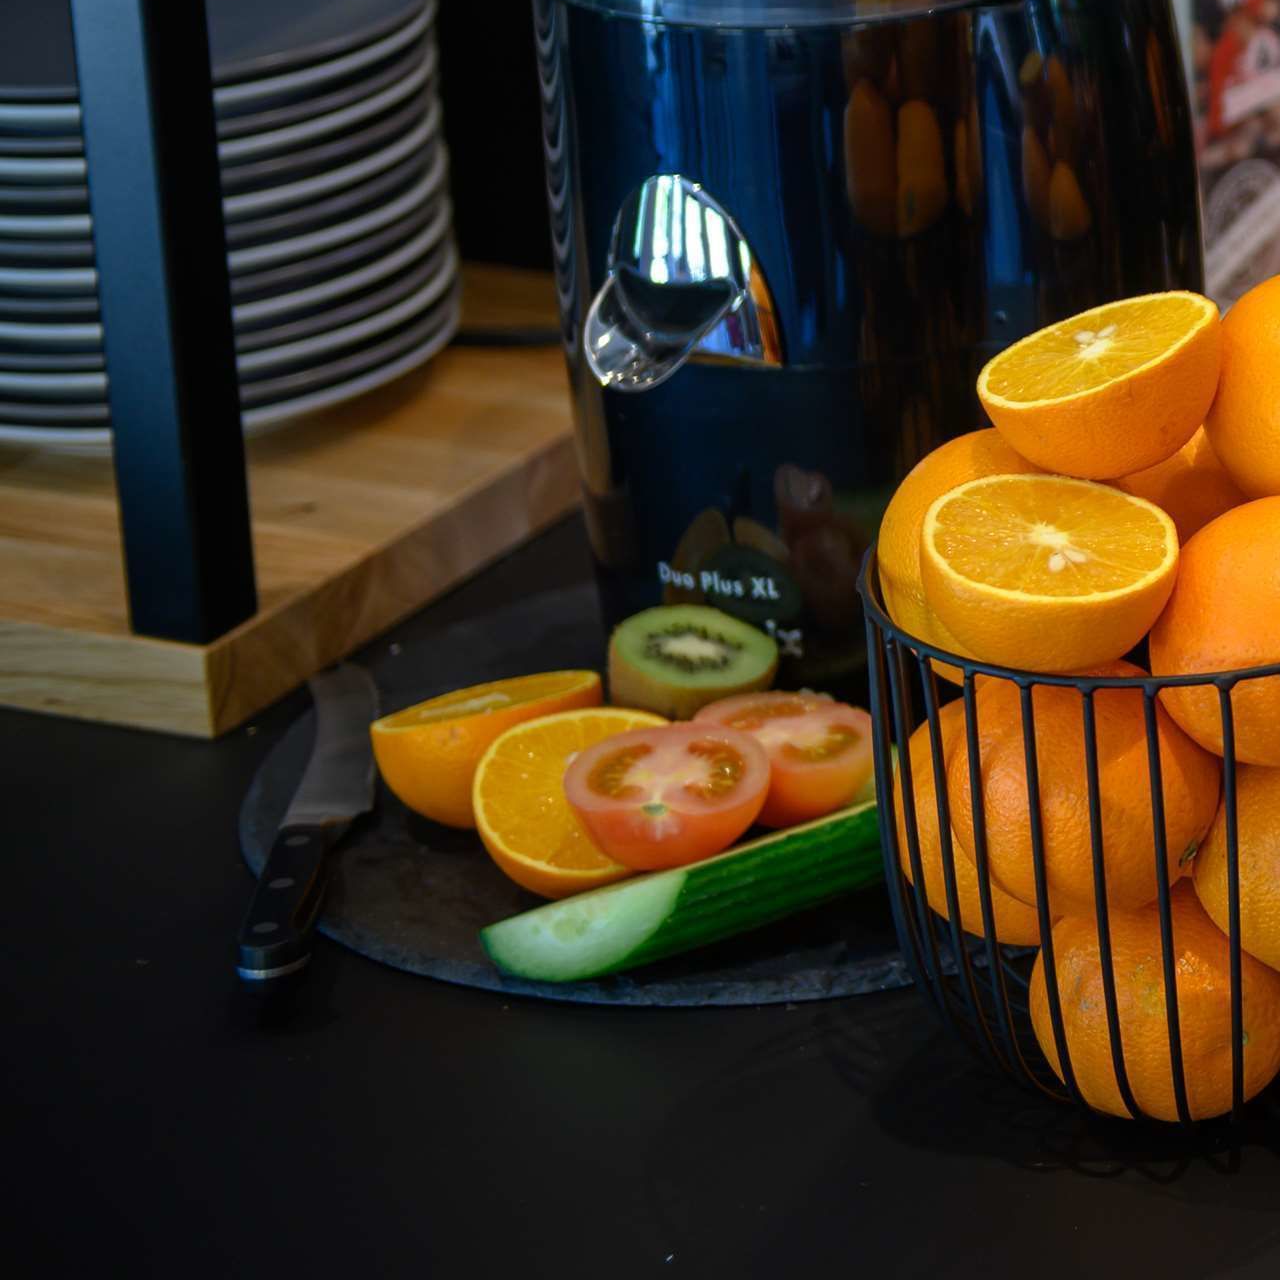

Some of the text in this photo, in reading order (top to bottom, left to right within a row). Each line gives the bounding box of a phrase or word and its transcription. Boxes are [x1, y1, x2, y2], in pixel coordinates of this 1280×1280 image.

[657, 561, 780, 600] Duo Plus XL
